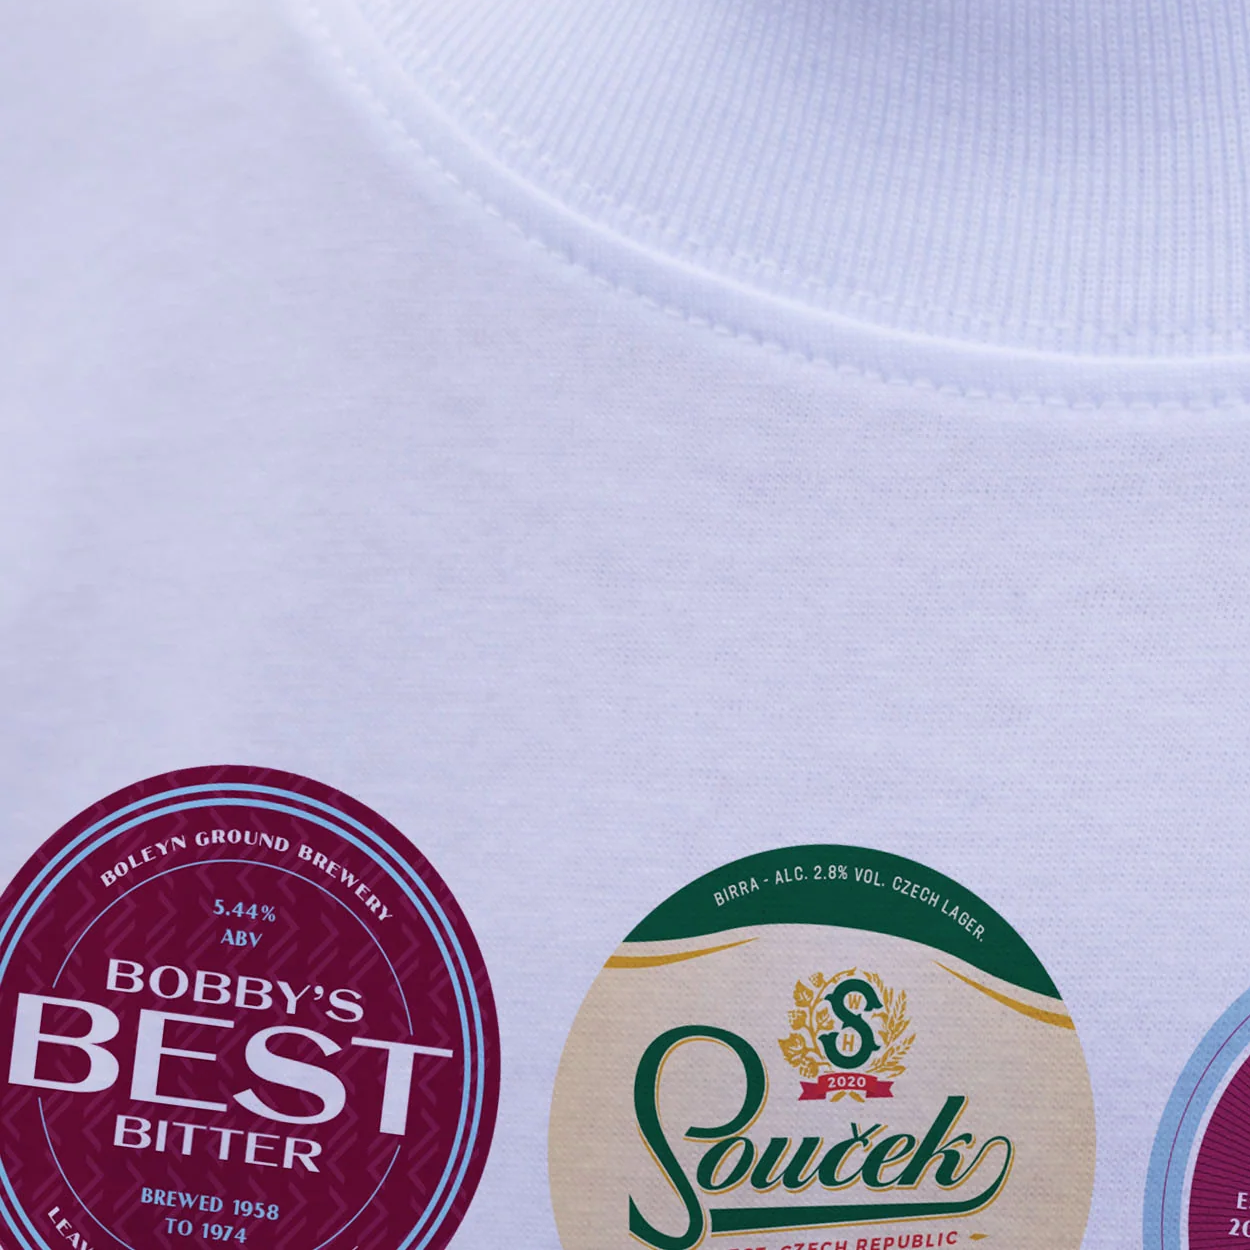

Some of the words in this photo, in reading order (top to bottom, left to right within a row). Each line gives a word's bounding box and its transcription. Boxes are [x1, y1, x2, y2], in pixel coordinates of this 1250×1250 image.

[100, 835, 187, 887] BOLEYN
[195, 829, 290, 852] GROUND
[298, 845, 393, 922] BREWERY
[213, 899, 276, 922] 5.44%
[713, 877, 760, 907] BIRRA
[775, 866, 808, 885] ALC.
[813, 865, 848, 880] 2.8%
[855, 867, 885, 887] VOL.
[892, 876, 940, 907] CZECH
[941, 899, 985, 942] LAGER.
[221, 929, 263, 948] ABV
[8, 992, 453, 1136] BEST
[827, 1076, 867, 1088] 2020
[113, 1115, 322, 1173] BITTER
[141, 1187, 223, 1212] BREWED
[233, 1199, 279, 1220] 1958
[165, 1218, 193, 1236] TO
[202, 1223, 247, 1243] 1974
[856, 1230, 958, 1250] REPUBLIC
